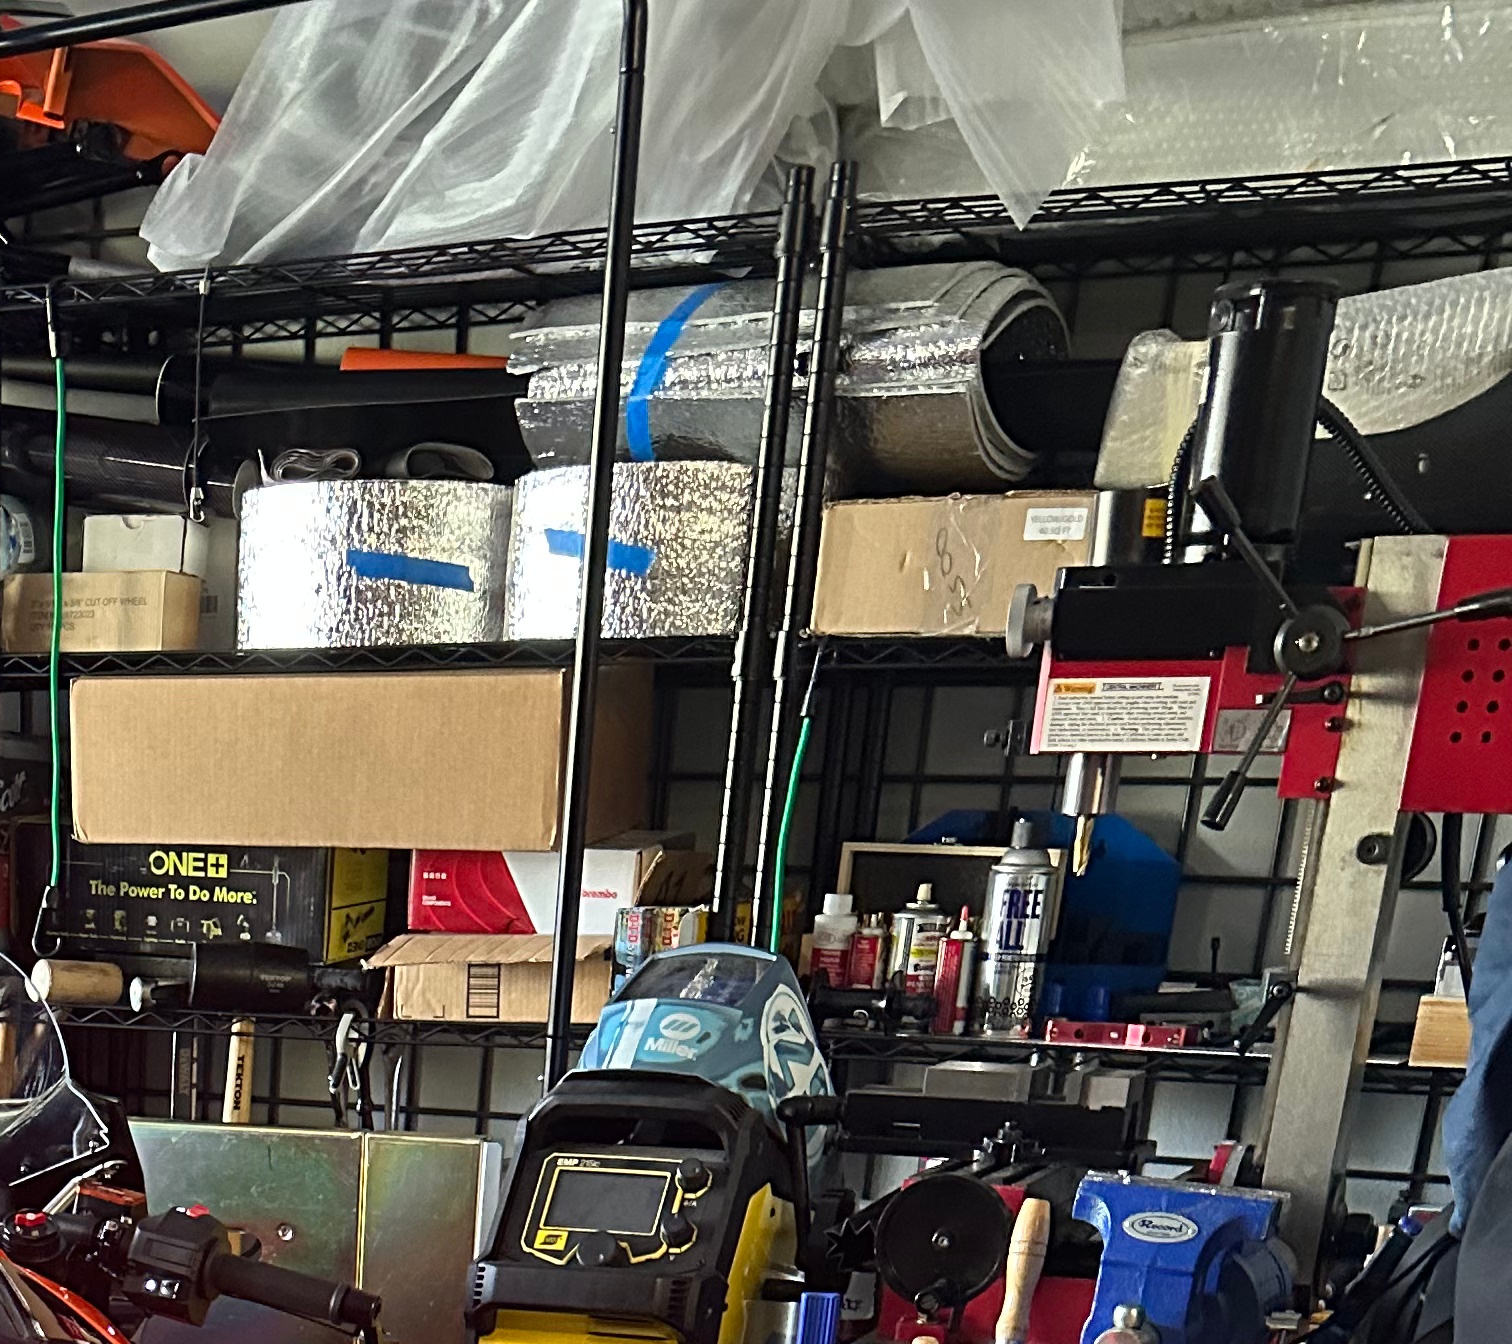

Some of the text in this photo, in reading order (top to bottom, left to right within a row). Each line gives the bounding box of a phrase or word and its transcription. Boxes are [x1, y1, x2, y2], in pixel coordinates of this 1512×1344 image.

[90, 880, 116, 897] The
[119, 881, 166, 902] Power
[168, 883, 185, 900] To
[188, 885, 210, 902] Do
[643, 1036, 693, 1060] Miller
[556, 1158, 579, 1166] EMP
[1138, 1219, 1183, 1233] Record
